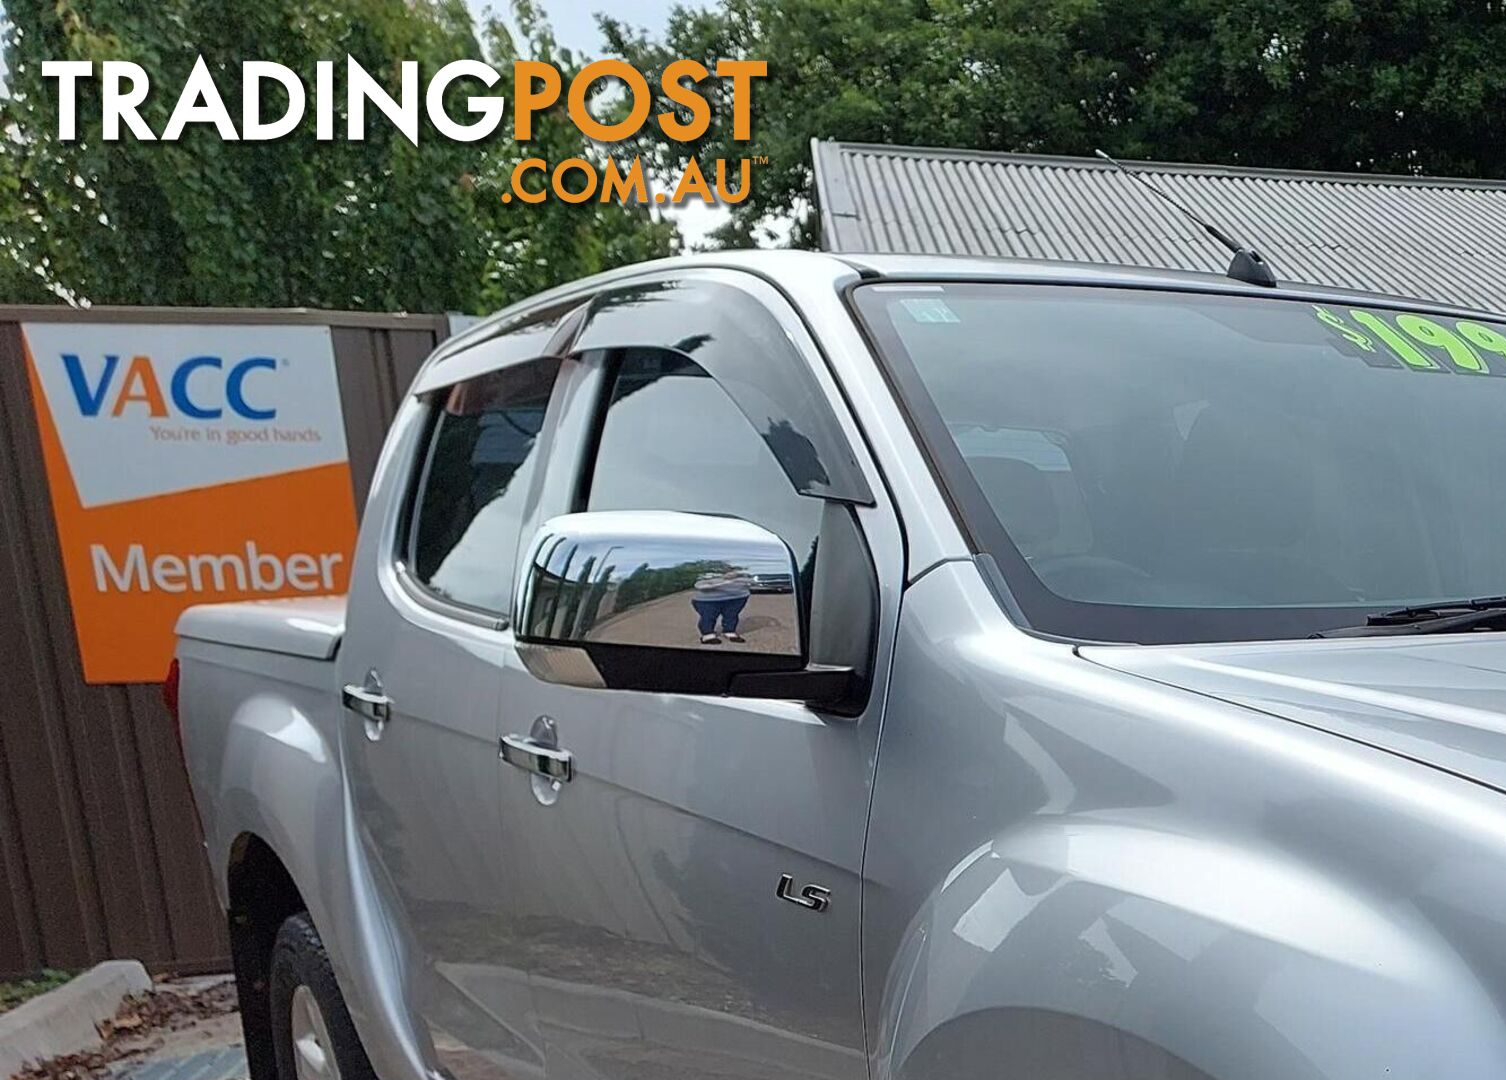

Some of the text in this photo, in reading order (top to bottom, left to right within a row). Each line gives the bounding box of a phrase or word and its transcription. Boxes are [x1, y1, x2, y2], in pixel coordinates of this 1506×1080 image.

[60, 354, 276, 420] VACC
[150, 426, 322, 446] You're in good hands
[90, 540, 343, 593] Member
[776, 872, 831, 912] LS
